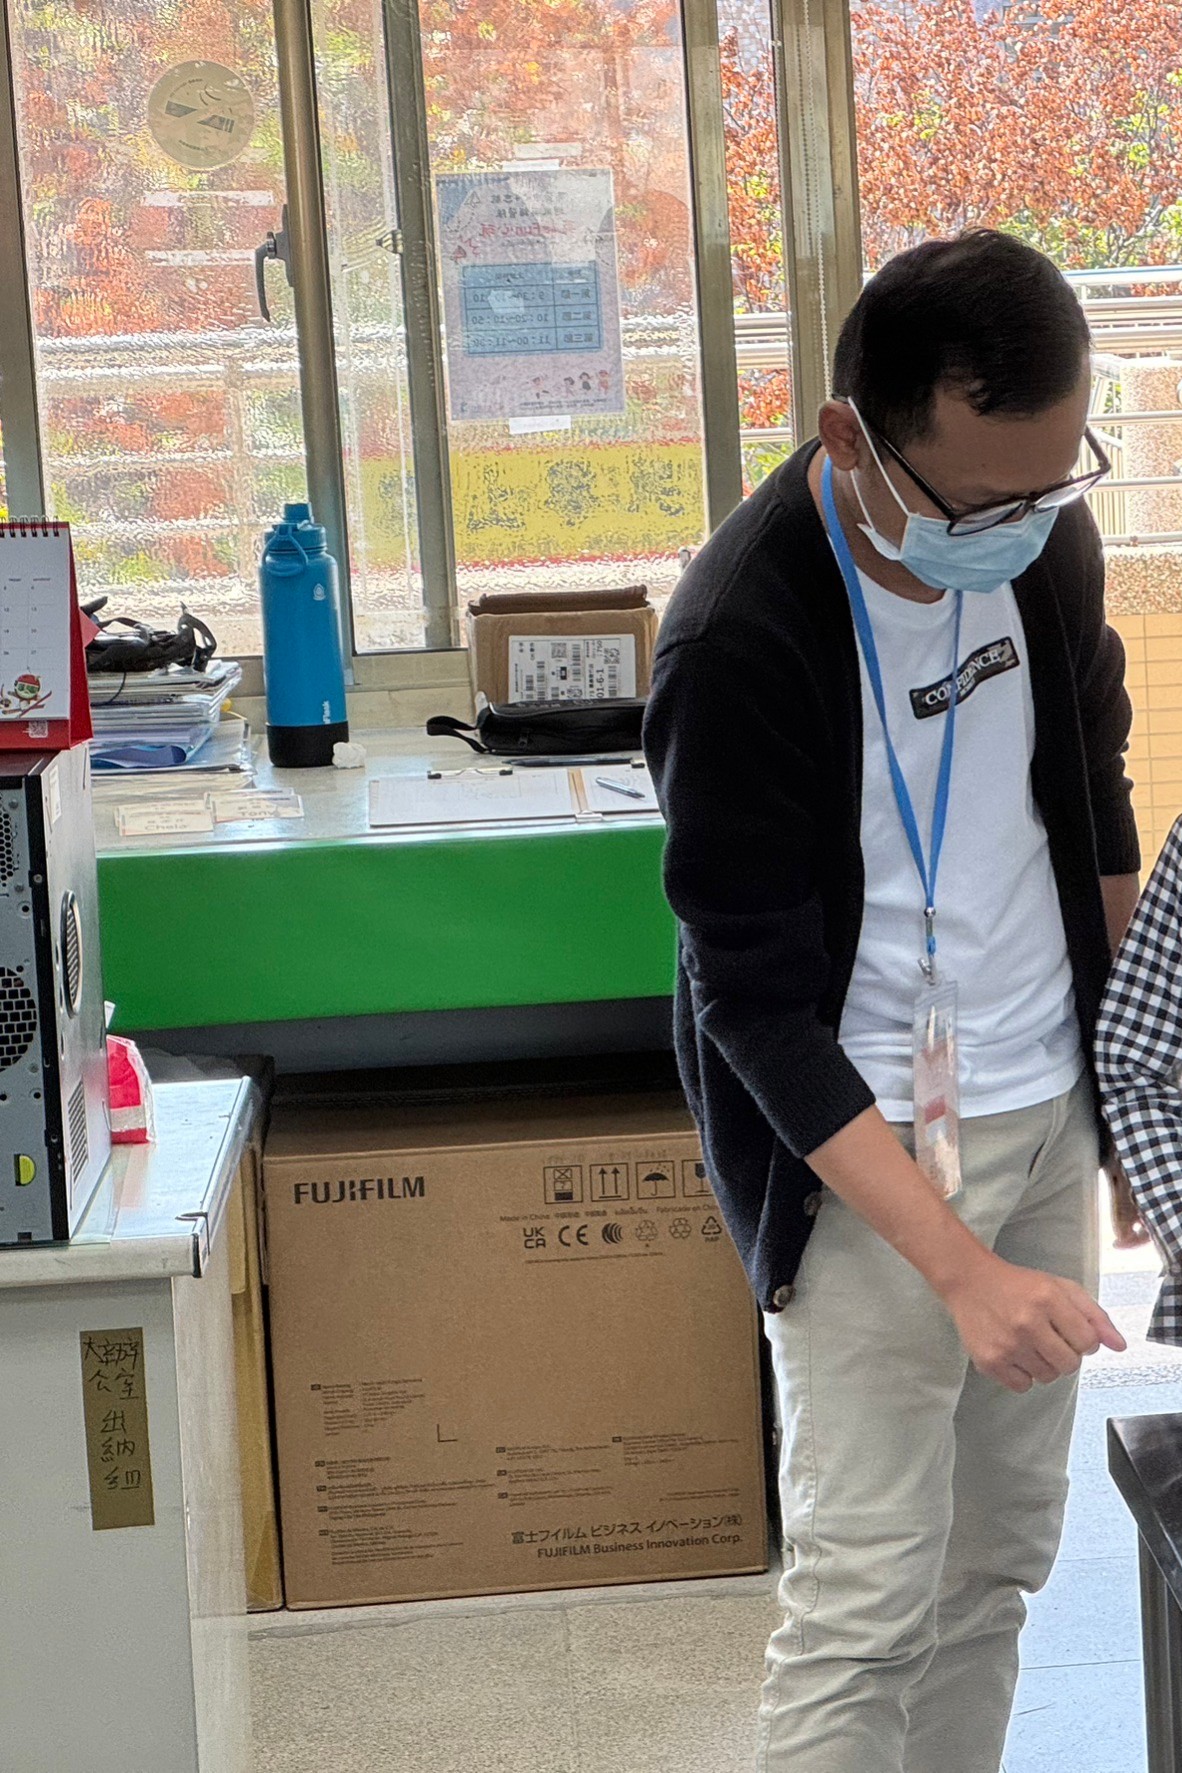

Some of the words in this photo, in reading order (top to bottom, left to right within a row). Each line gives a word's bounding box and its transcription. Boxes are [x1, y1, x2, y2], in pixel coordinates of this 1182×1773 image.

[294, 1176, 425, 1204] FUJIFILM
[522, 1226, 546, 1238] UK
[523, 1237, 547, 1249] CA
[558, 1224, 589, 1247] CE
[511, 1528, 587, 1545] 富士フイルム
[590, 1521, 642, 1538] ビジネス
[537, 1545, 591, 1559] FUJIFILM
[593, 1540, 644, 1554] Business
[646, 1535, 710, 1550] Innovation
[711, 1531, 744, 1546] Corp.
